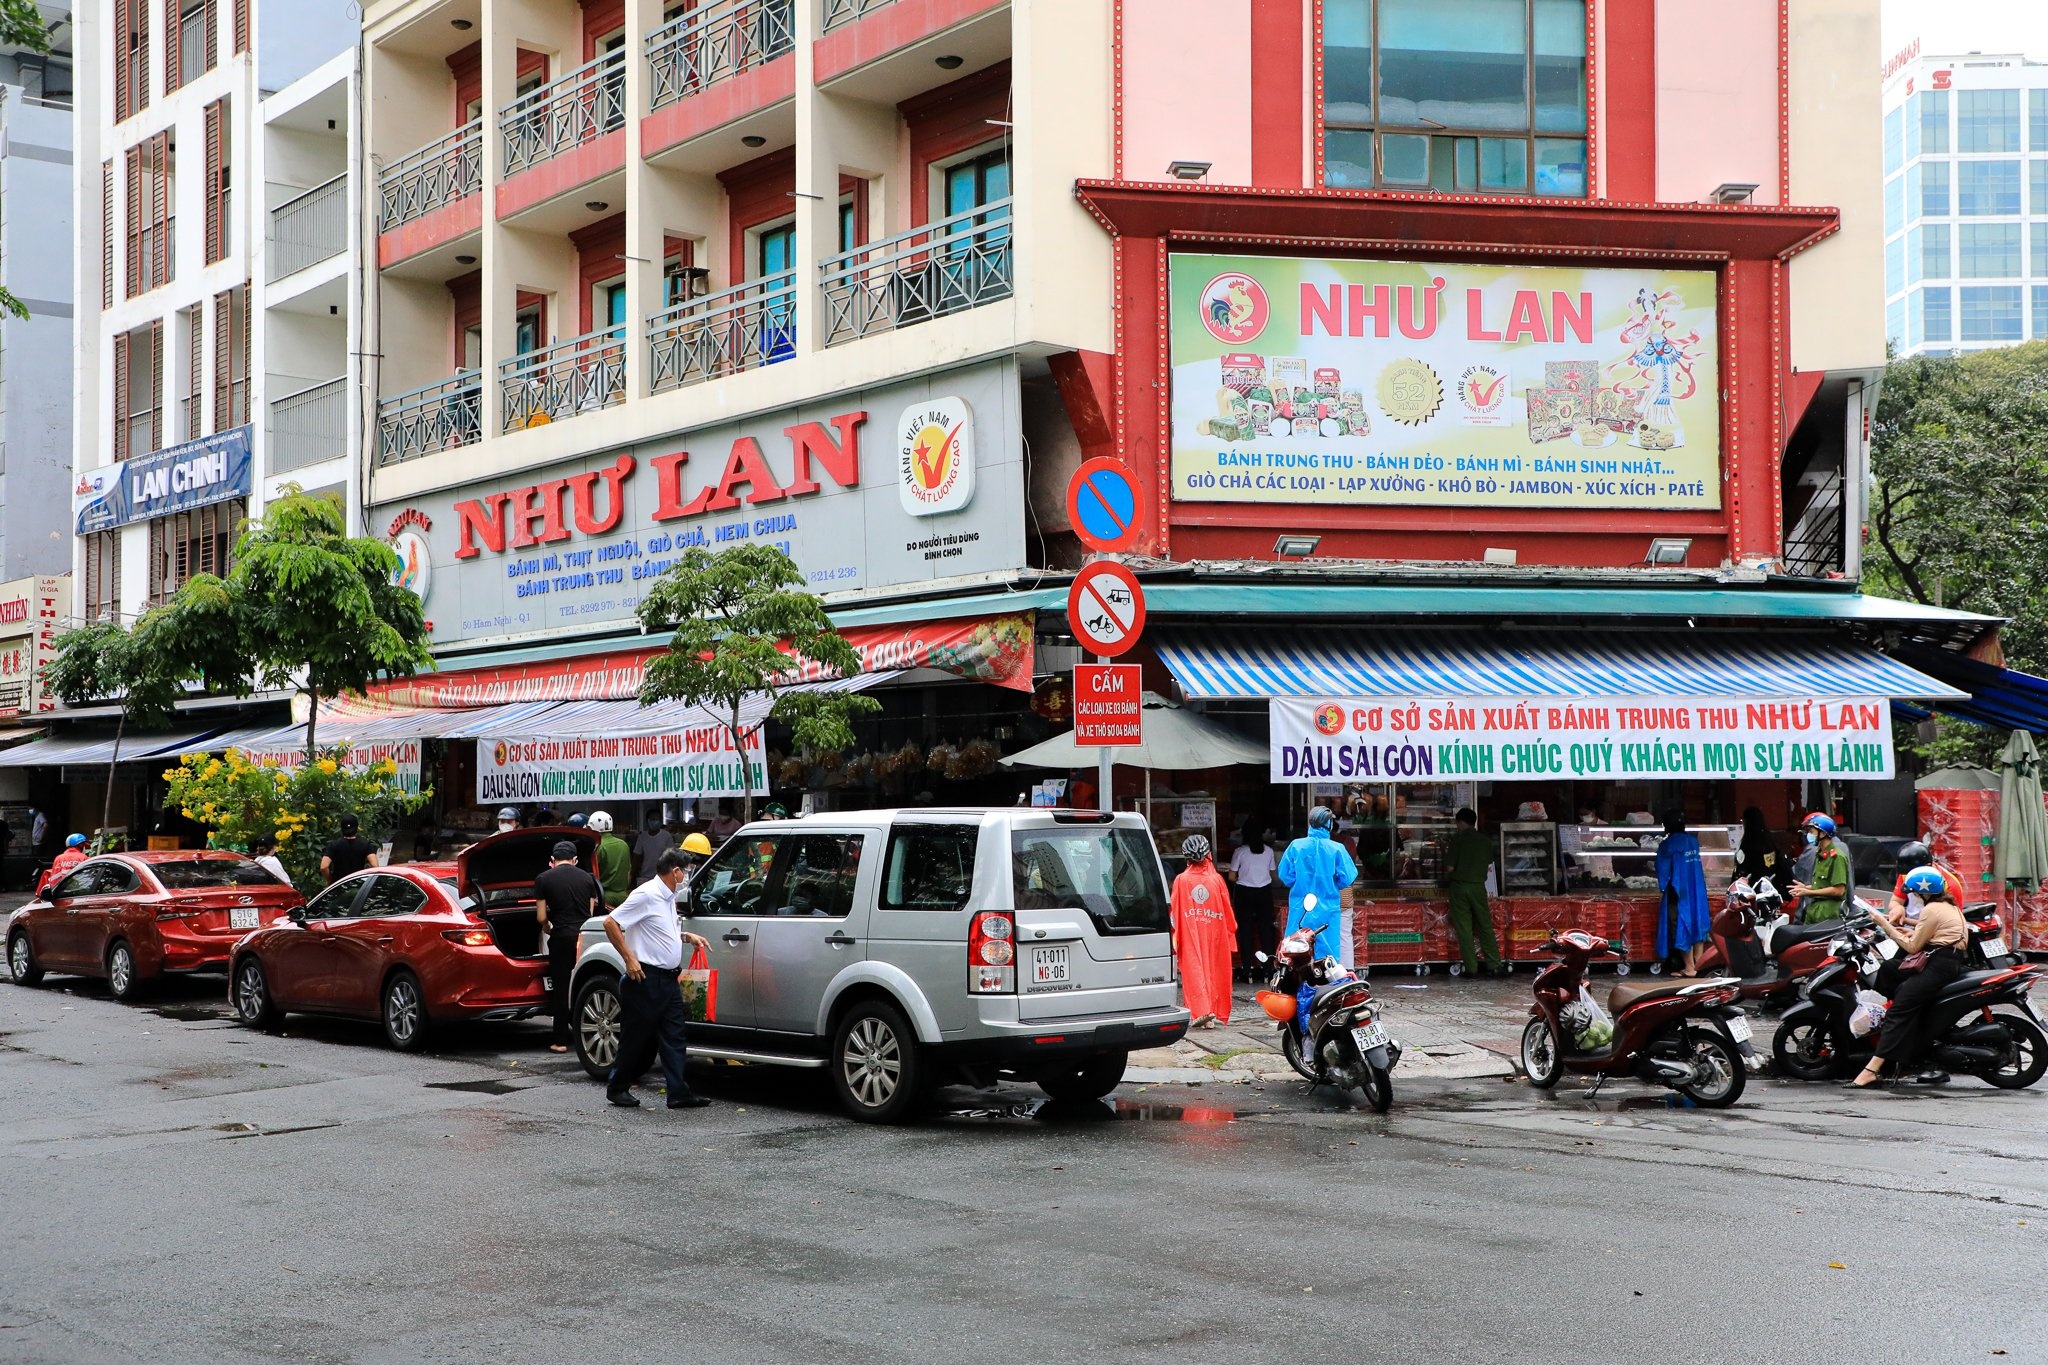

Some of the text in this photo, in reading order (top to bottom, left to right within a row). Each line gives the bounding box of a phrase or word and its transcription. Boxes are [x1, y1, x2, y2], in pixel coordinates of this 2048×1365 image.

[1300, 276, 1593, 344] NHƯ LAN
[1480, 365, 1497, 377] NAM
[1392, 382, 1426, 401] 52
[902, 410, 950, 485] HÀNG VIỆT NAM
[911, 439, 960, 502] CHẤT LƯỢNG CAO
[1218, 451, 1262, 467] BÁNH
[1267, 453, 1319, 468] TRUNG
[1323, 455, 1353, 468] THU
[1366, 453, 1409, 470] BÁNH
[1413, 453, 1444, 470] DẺO
[1456, 455, 1498, 471] BÁNH
[1503, 456, 1522, 471] MÌ
[1534, 457, 1577, 473] BÁNH
[1581, 460, 1617, 474] SINH
[133, 467, 169, 504] LAN
[172, 451, 227, 494] CHINH
[454, 411, 867, 560] NHƯ LAN
[1187, 470, 1215, 489] GIÒ
[1219, 469, 1251, 489] CHẢ
[1255, 471, 1287, 490] CÁC
[1290, 475, 1325, 493] LOẠI
[1338, 477, 1367, 494] LẠP
[1369, 473, 1426, 492] XƯỞNG
[1438, 476, 1475, 493] KHÔ
[1476, 477, 1497, 494] BÒ
[1509, 481, 1574, 495] JAMBON
[1584, 479, 1616, 495] XÚC
[1619, 480, 1655, 496] XÍCH
[1668, 480, 1705, 497] PATÊ
[507, 513, 797, 578] BÁNH MÌ, THỊT NGUỘI, GIÒ CHẢ, NEM CHUA
[907, 530, 980, 551] DO NGƯỜI TIÊU DÙNG
[924, 547, 963, 561] BÌNH CHỌN
[516, 579, 550, 598] BÁNH
[551, 571, 595, 592] TRUNG
[597, 567, 623, 585] THU
[631, 556, 674, 581] BÁNH
[810, 566, 858, 582] 8214 236
[580, 602, 600, 614] 8292
[600, 601, 616, 611] 970
[1091, 667, 1124, 693] CẤM
[1078, 701, 1138, 717] CÁC LOẠI XE 03 BÁNH
[1352, 699, 1880, 731] CƠ SỞ SẢN XUẤT BÁNH TRUNG THU NHƯ LAN
[509, 743, 522, 763] CƠ
[524, 738, 537, 761] SỞ
[539, 736, 560, 761] SẢN
[562, 734, 588, 760] XUẤT
[591, 732, 618, 759] BÁNH
[622, 736, 657, 757] TRUNG
[660, 734, 682, 754] THU
[685, 723, 722, 753] NHƯ
[1077, 724, 1085, 737] VÀ
[1086, 725, 1094, 737] XE
[1095, 723, 1106, 737] THÔ
[1116, 726, 1123, 737] 04
[1123, 723, 1140, 737] BÁNH
[355, 748, 369, 765] THU
[397, 743, 418, 764] LAN
[1339, 735, 1379, 777] SÀI
[1384, 735, 1433, 776] GÒN
[1438, 738, 1494, 773] KÍNH
[1501, 738, 1563, 773] CHÚC
[1570, 737, 1613, 776] QUÝ
[1622, 737, 1697, 772] KHÁCH
[1703, 742, 1746, 778] MỌI
[1754, 740, 1785, 778] SỰ
[1791, 743, 1820, 772] AN
[1828, 737, 1884, 772] LÀNH
[505, 767, 520, 797] SÀI
[520, 766, 540, 796] GÒN
[541, 766, 566, 796] KÍNH
[568, 765, 596, 795] CHÚC
[598, 763, 620, 798] QUÝ
[622, 762, 659, 793] KHÁCH
[662, 766, 685, 798] MỌI
[688, 763, 705, 798] SỰ
[707, 765, 725, 790] AN
[1402, 889, 1425, 897] QUAY
